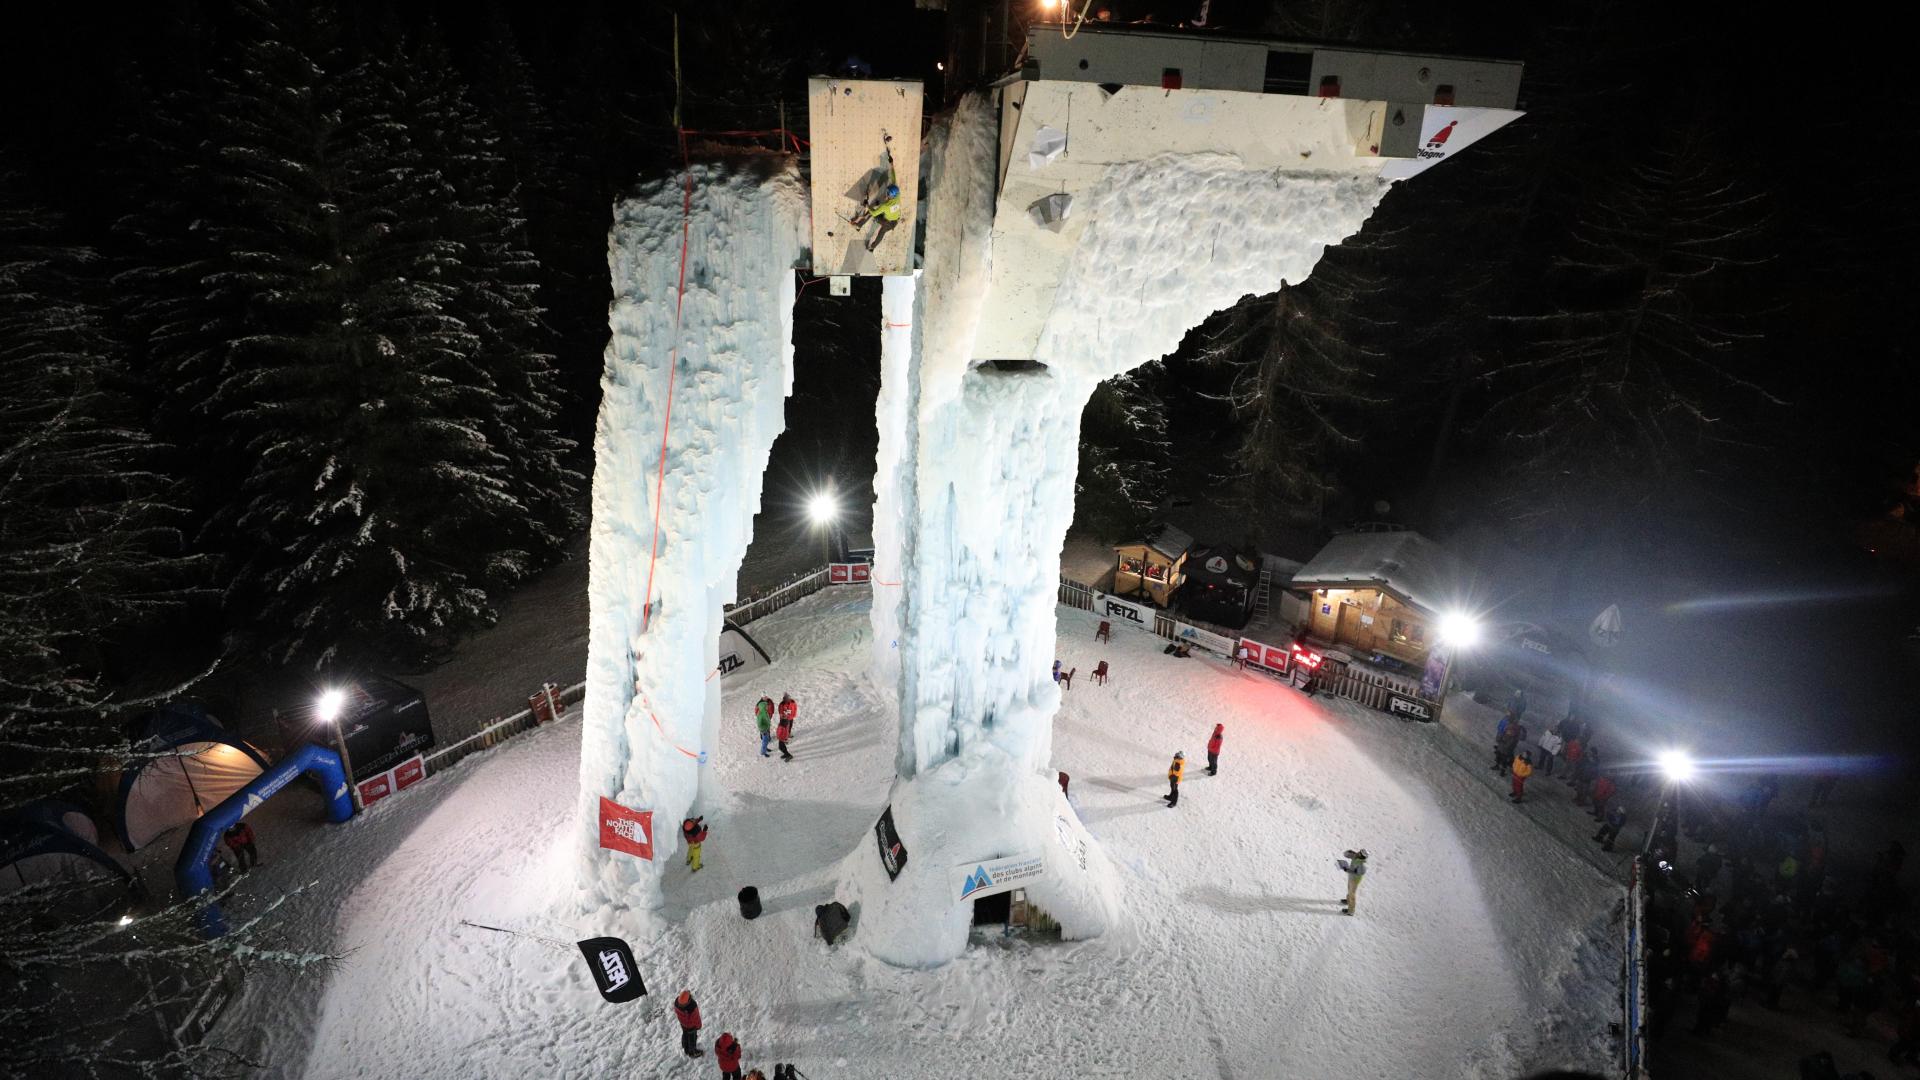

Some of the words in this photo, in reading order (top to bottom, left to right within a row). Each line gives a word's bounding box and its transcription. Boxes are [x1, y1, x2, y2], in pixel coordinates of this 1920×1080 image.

[1106, 601, 1144, 623] PETZL
[1391, 697, 1430, 718] PETZL
[992, 871, 1004, 879] des
[1005, 866, 1022, 876] clubs
[1024, 862, 1042, 872] alpins
[1013, 868, 1043, 880] montagne
